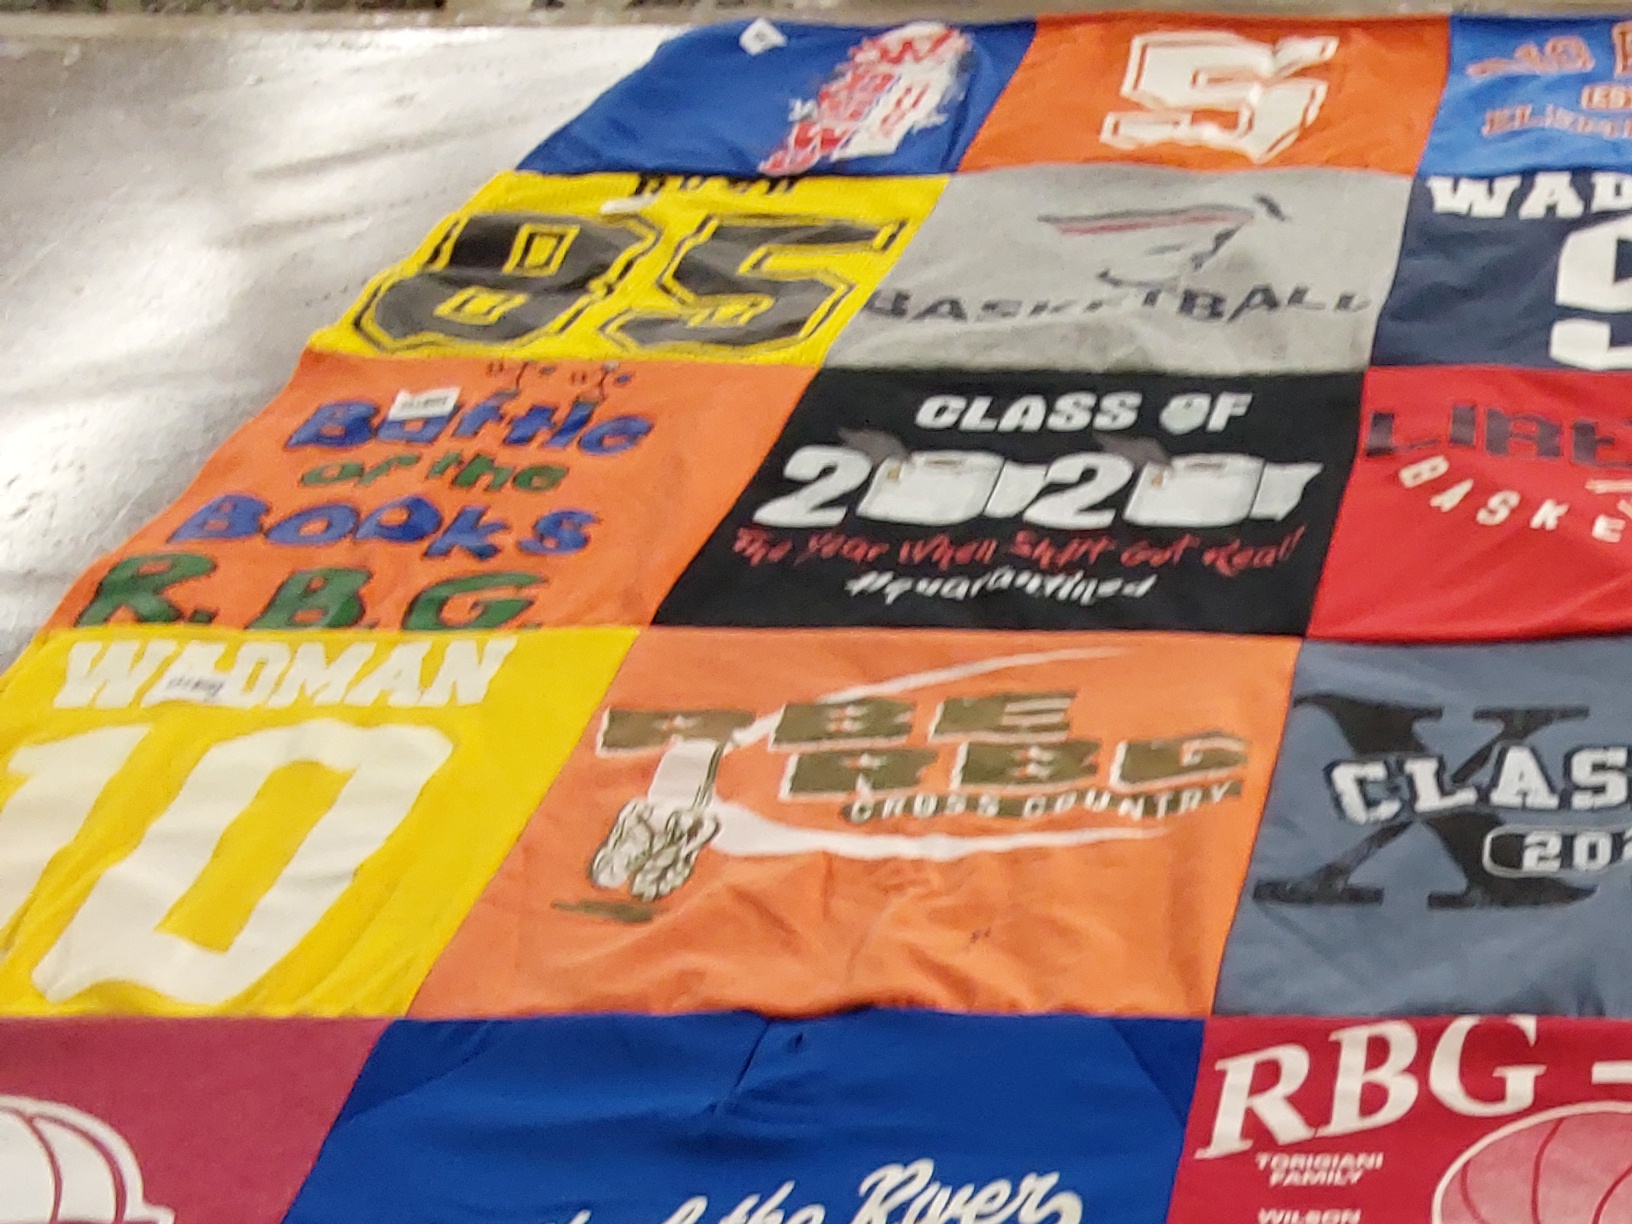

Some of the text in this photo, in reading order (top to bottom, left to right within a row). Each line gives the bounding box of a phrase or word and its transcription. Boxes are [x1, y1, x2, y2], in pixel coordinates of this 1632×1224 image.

[915, 391, 1253, 435] CLASS OF
[53, 636, 518, 709] WADMAN
[0, 717, 455, 1006] 10
[1194, 1015, 1546, 1159] RBG
[1269, 1169, 1364, 1187] FAMILY
